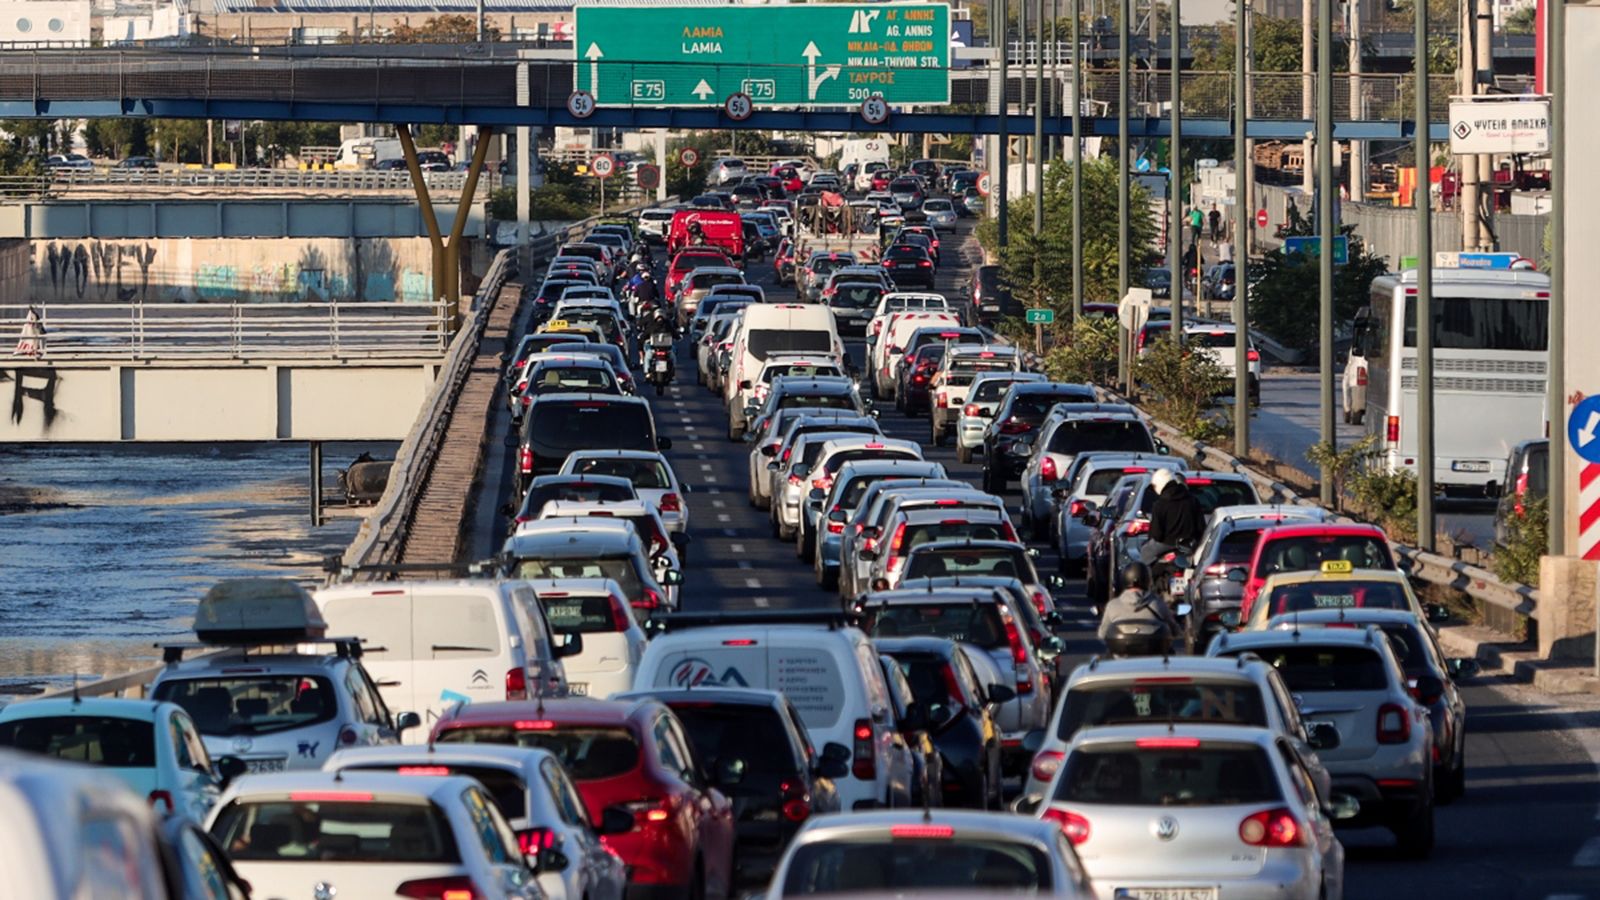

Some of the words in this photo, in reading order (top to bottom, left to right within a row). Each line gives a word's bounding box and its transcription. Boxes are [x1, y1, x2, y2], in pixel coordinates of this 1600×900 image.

[683, 26, 723, 38] ΛΑΜΙΑ
[886, 26, 901, 36] AG.
[905, 25, 933, 36] ANNIS
[682, 42, 722, 53] LAMIA
[921, 56, 941, 67] STR.
[849, 72, 895, 84] ΤΑΥΡΟΣ
[633, 84, 642, 96] E
[646, 83, 662, 96] 75
[744, 83, 753, 96] E
[756, 83, 772, 95] 75
[848, 89, 869, 99] 500
[596, 161, 609, 170] 80
